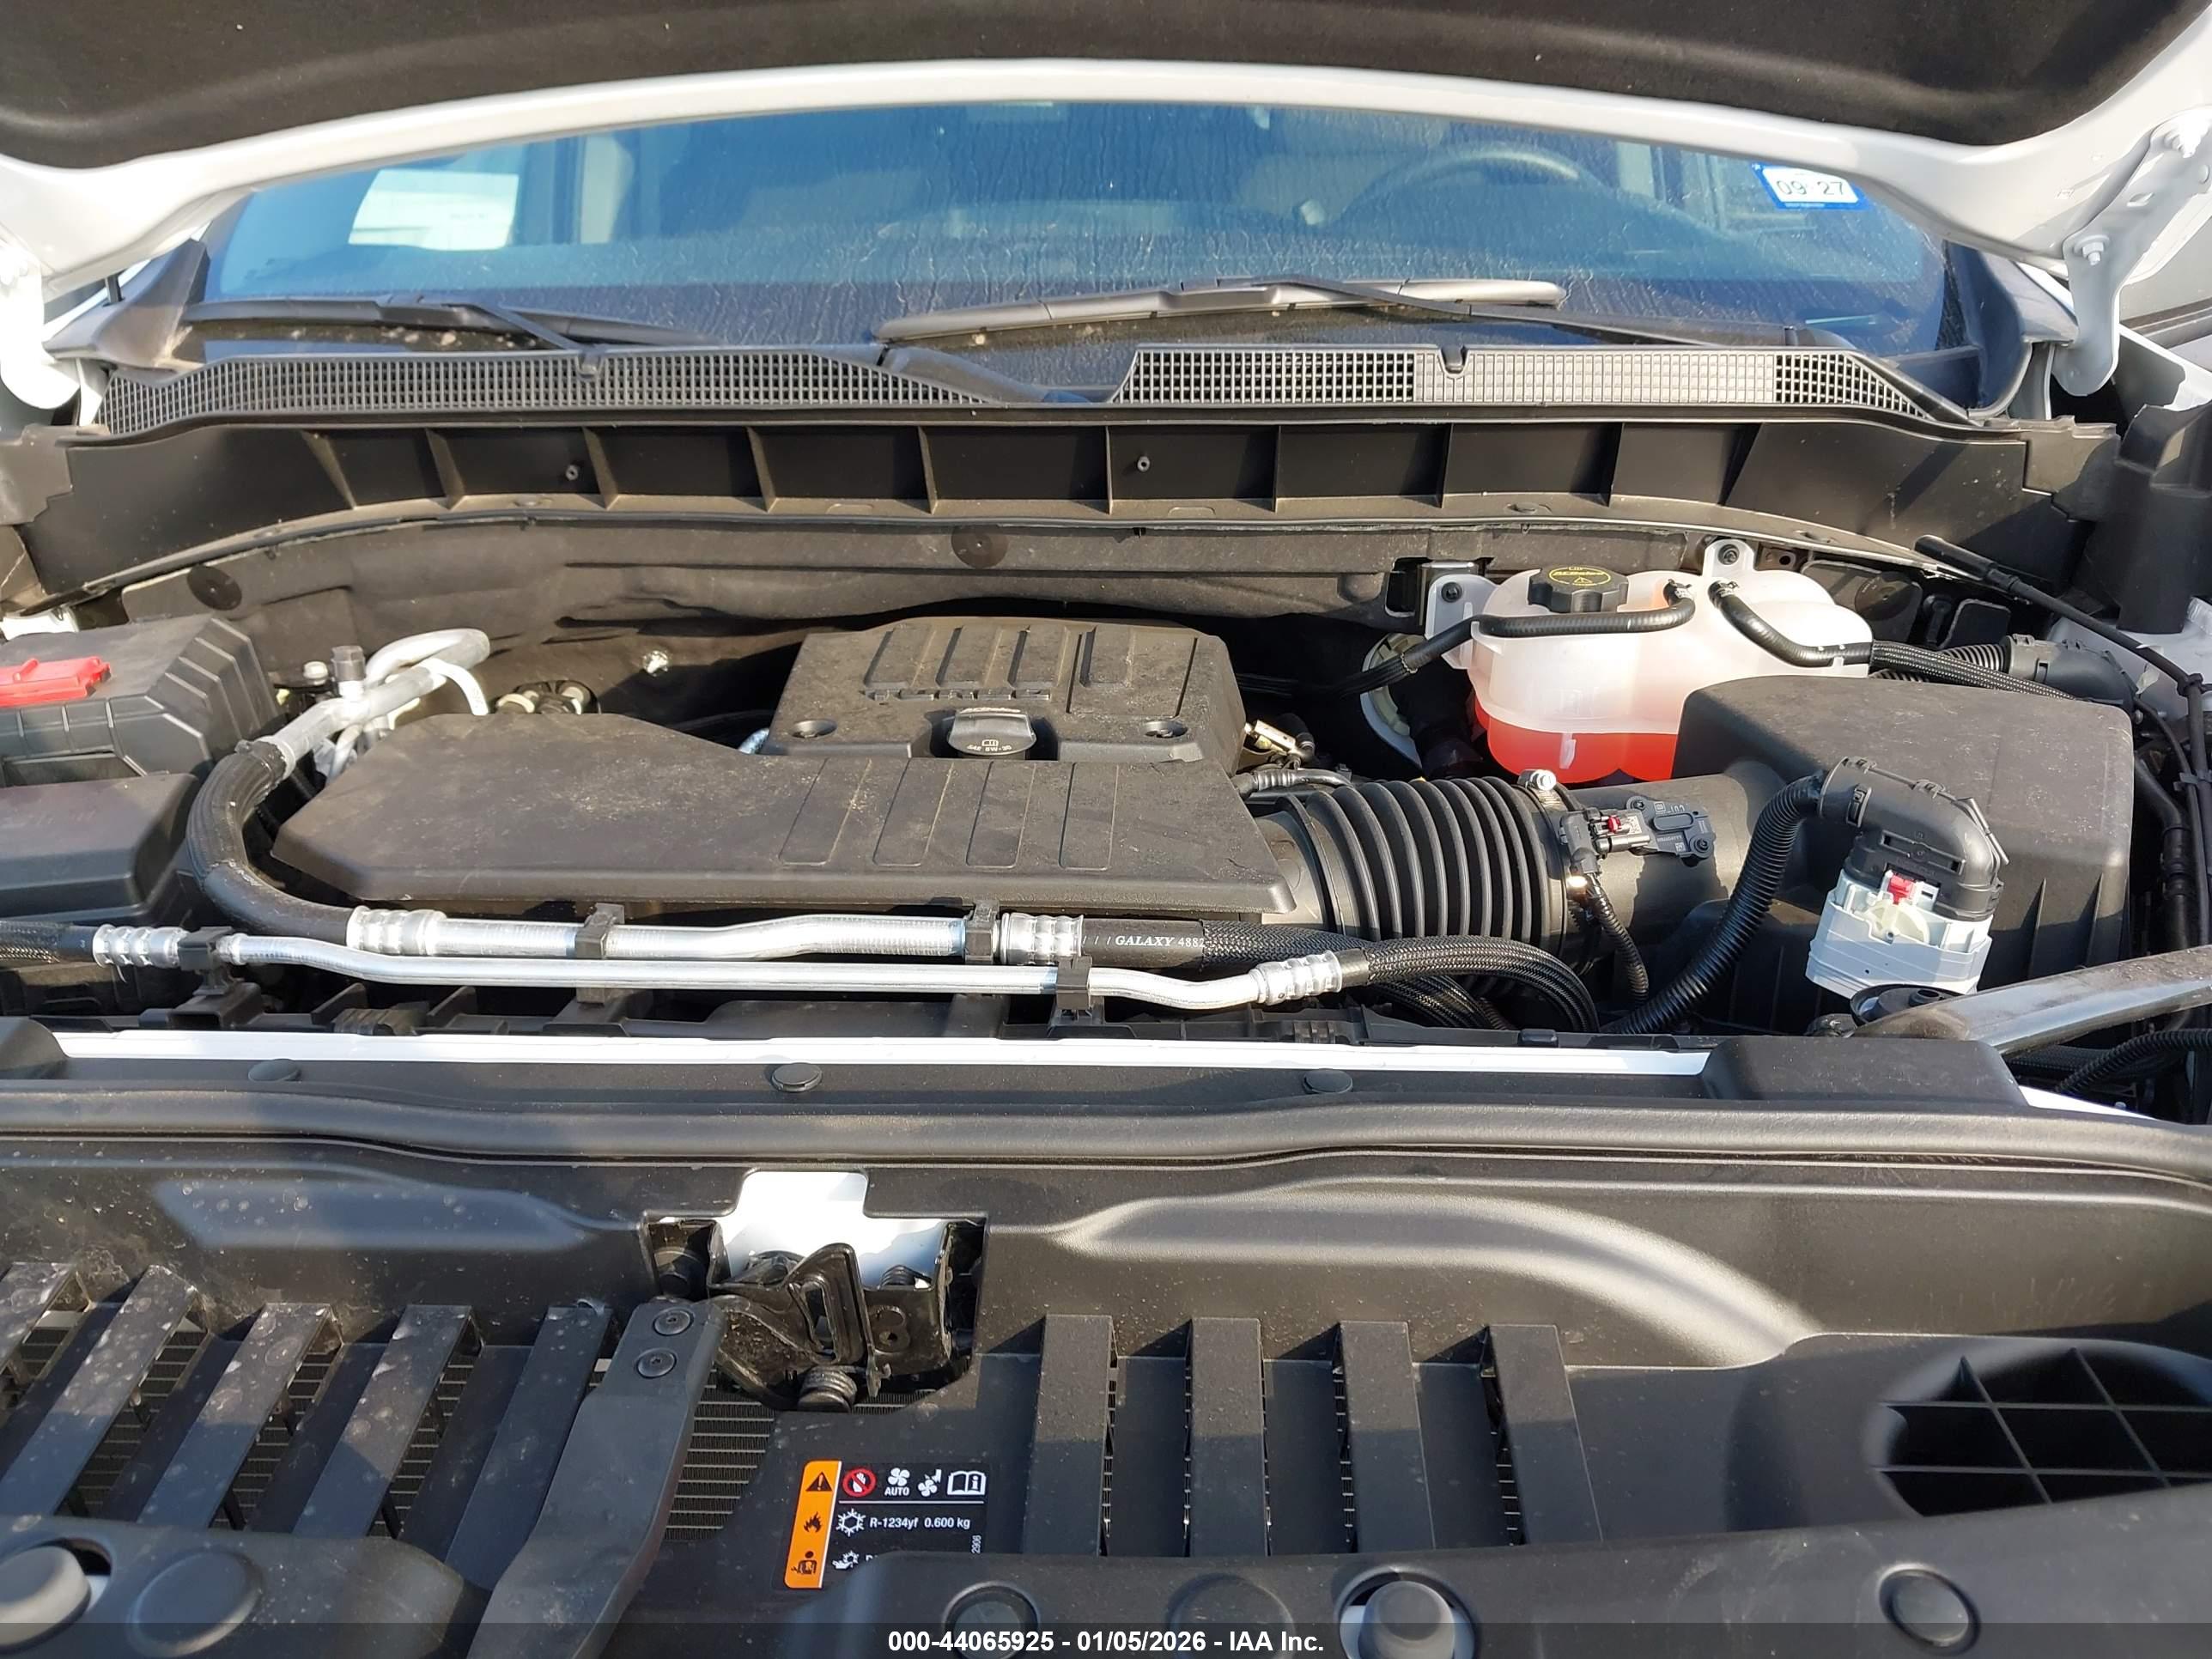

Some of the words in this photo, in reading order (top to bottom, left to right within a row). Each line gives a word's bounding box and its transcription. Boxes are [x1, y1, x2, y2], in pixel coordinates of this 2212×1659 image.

[1776, 179, 1808, 196] 09
[1816, 180, 1844, 196] 27
[1115, 935, 1176, 946] GALAXY
[884, 1486, 910, 1496] AUTO
[869, 1516, 919, 1530] R-1234yf
[924, 1516, 955, 1528] 0.600
[957, 1516, 971, 1530] kg
